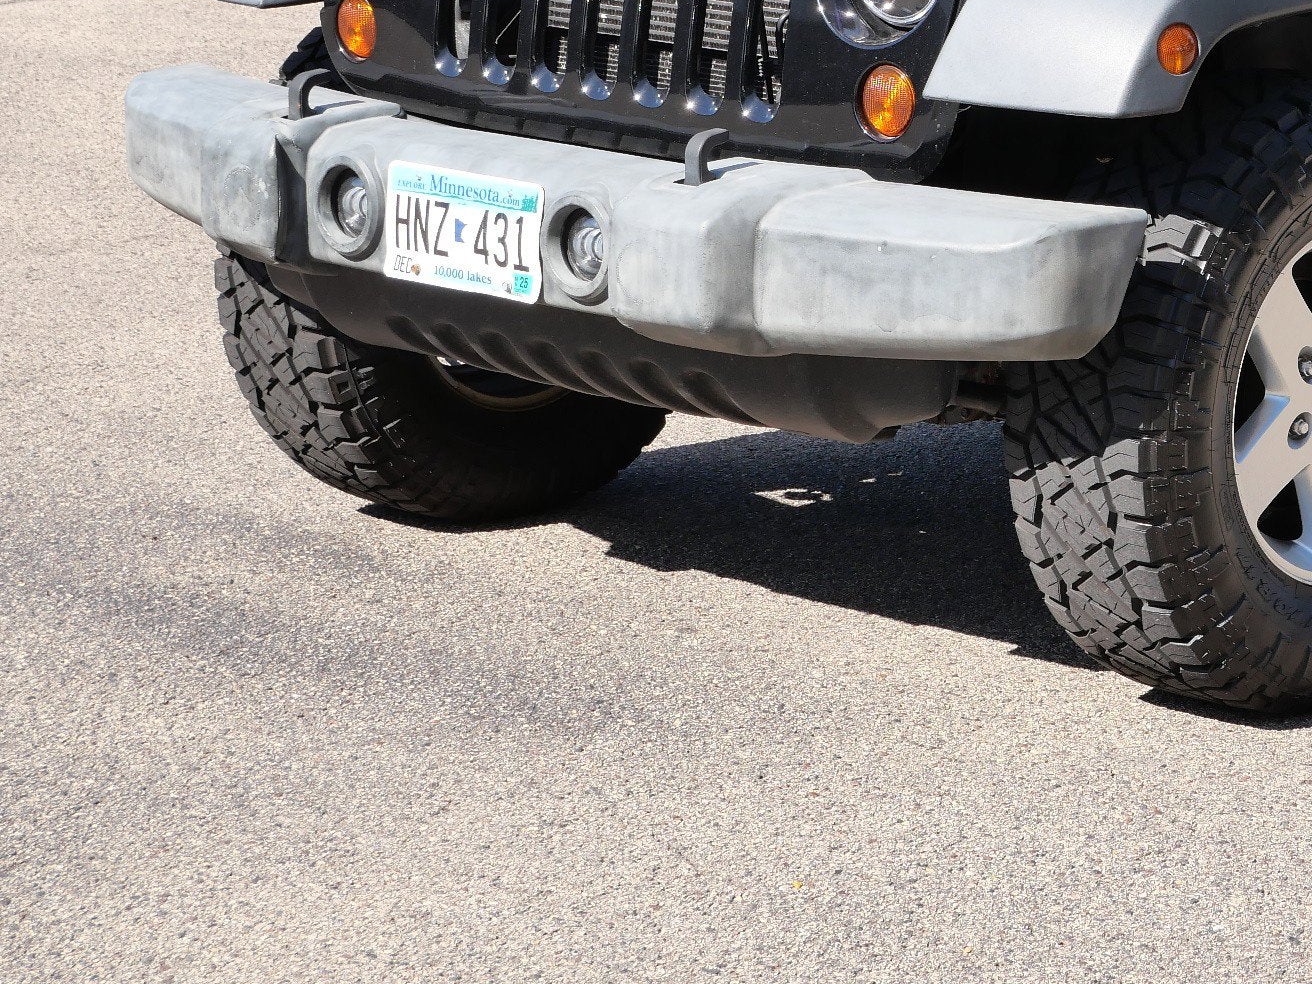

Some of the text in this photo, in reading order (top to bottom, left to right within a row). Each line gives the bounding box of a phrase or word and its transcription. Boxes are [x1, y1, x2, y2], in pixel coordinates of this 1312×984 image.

[395, 194, 530, 272] HNZ 431
[393, 255, 413, 274] DEC
[466, 270, 492, 285] lakes
[519, 276, 529, 289] 25
